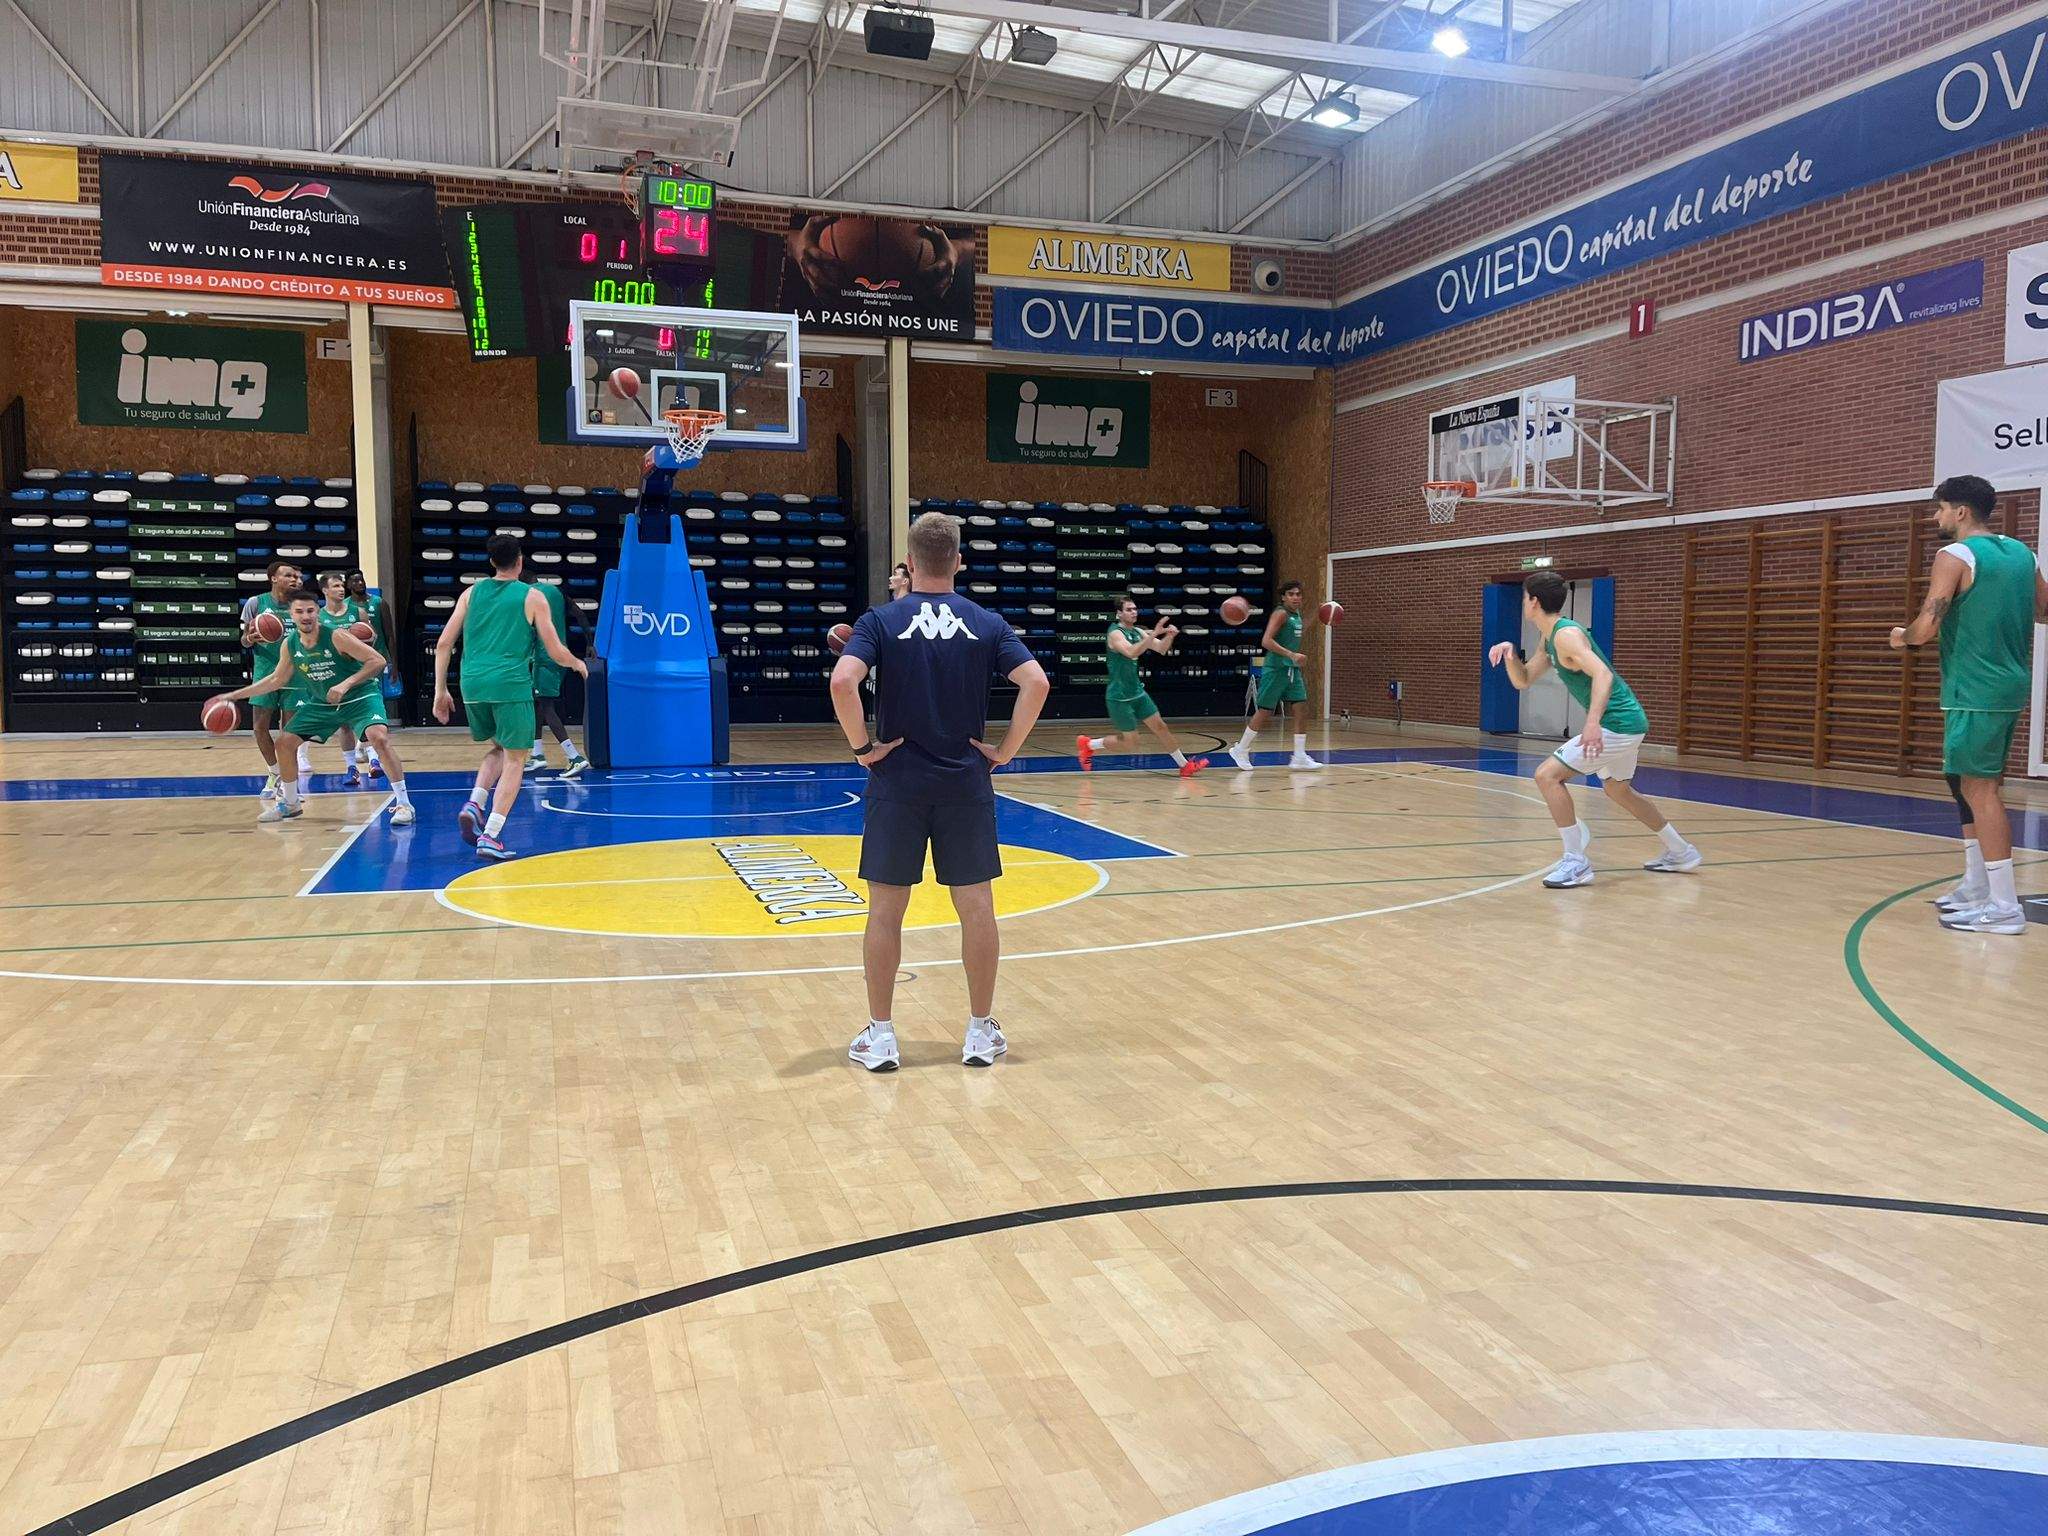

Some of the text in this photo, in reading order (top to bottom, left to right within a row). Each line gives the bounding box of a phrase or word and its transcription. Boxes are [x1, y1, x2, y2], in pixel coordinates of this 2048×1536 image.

[1936, 32, 2046, 131] OV
[659, 181, 712, 207] 10:00
[198, 199, 360, 226] UniónFinancieraAsturiana
[564, 216, 587, 225] LOCAL
[250, 220, 311, 236] Desde 1984
[655, 210, 710, 255] 24
[1437, 150, 1812, 314] OVIEDO capital del deporte
[149, 241, 407, 271] WWW.UNIONFINANCIERA.ES
[580, 232, 598, 262] 0
[1028, 238, 1193, 280] ALIMERKA
[606, 262, 633, 271] PERIODO
[114, 270, 445, 304] DESDE 1984 DANDO CRÉDITO A TUS SUEÑOS
[594, 279, 656, 306] 10:00
[822, 310, 882, 327] PASIÓN
[889, 315, 922, 330] NOS
[927, 318, 958, 332] UNE
[1638, 304, 1645, 332] 1
[1909, 302, 1958, 320] revitalizing
[1021, 298, 1384, 355] OVIEDO capital del deporte
[323, 340, 336, 357] F
[819, 370, 829, 386] 2
[1209, 390, 1234, 406] F 3
[124, 407, 221, 421] Tu seguro de salud
[631, 611, 691, 636] OVD
[606, 769, 816, 780] OVIEDO
[711, 842, 869, 925] ALIMERKA
